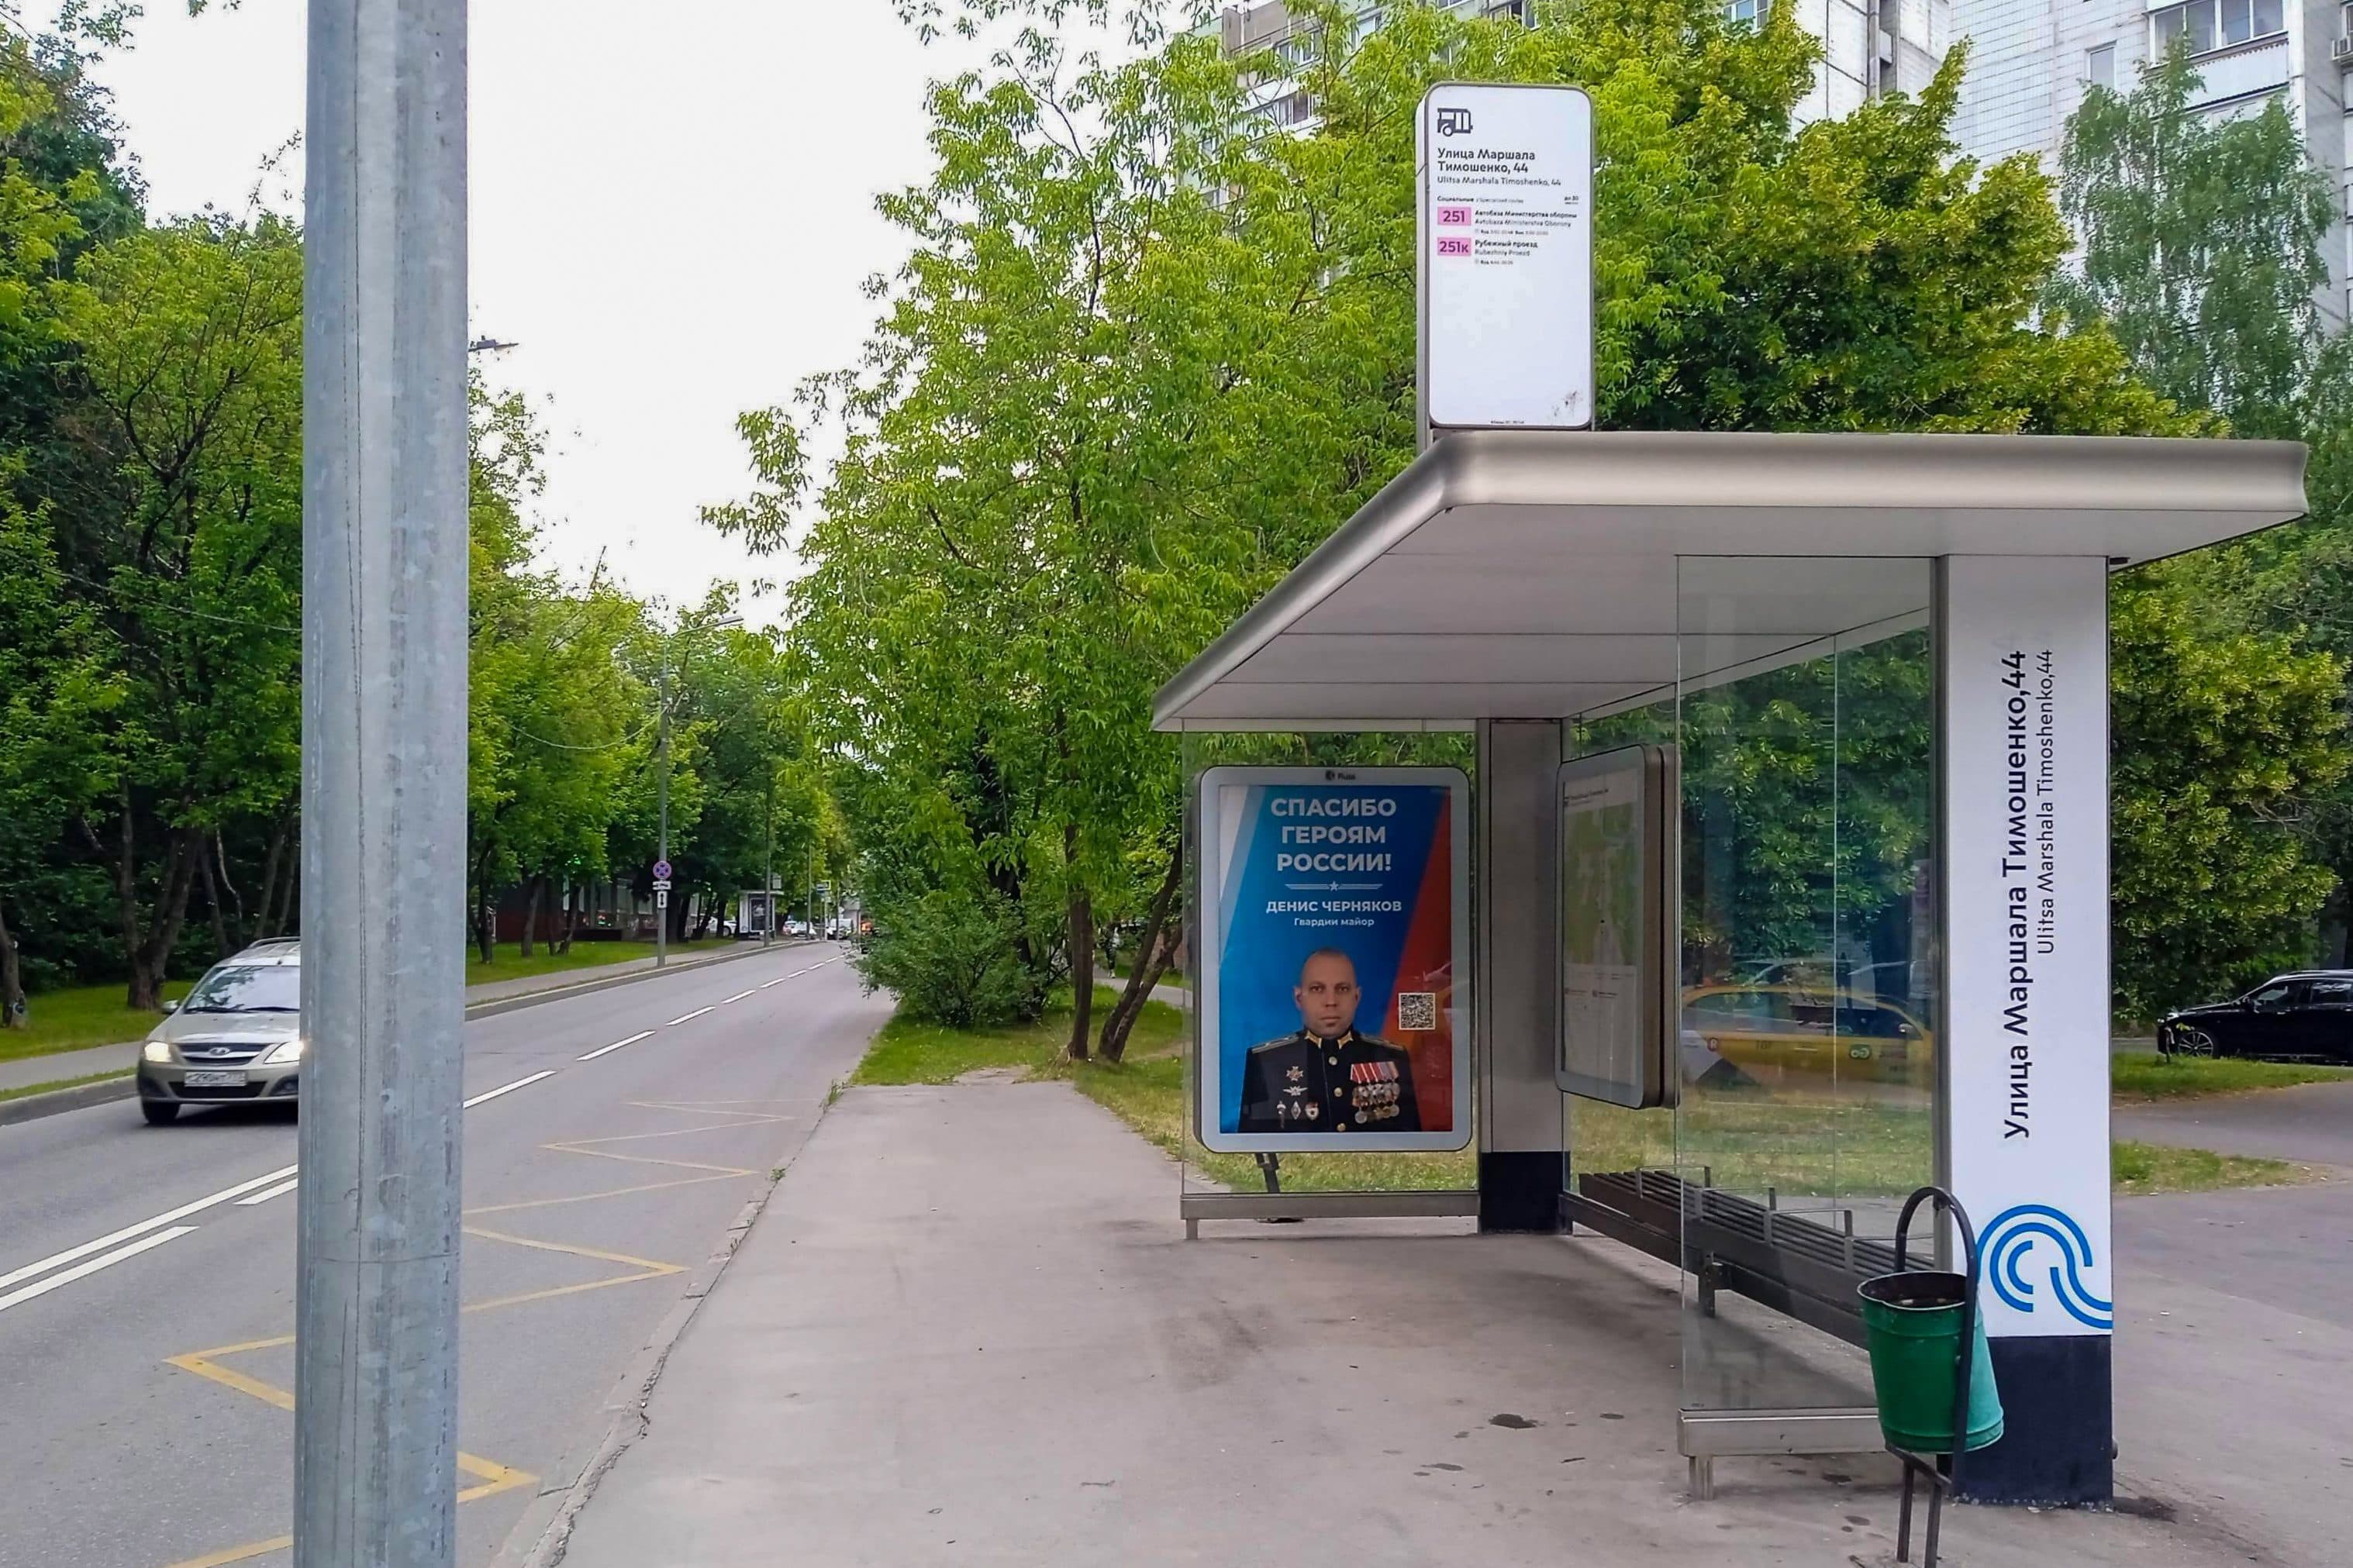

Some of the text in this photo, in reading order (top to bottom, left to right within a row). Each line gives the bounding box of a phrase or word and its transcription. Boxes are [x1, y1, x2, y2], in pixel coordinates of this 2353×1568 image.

[1437, 148, 1536, 161] Улица Маршала
[1437, 161, 1529, 174] Тимошенко, 44
[1462, 177, 1499, 185] Marshala
[1501, 177, 1550, 186] Timoshenko,
[1443, 210, 1465, 222] 251
[1271, 798, 1397, 817] СПАСИБО
[1282, 825, 1385, 843] ГЕРОЯМ
[2036, 801, 2054, 892] Marshala
[1277, 853, 1392, 871] РОССИИ!
[1266, 901, 1402, 914] ДЕНИС ЧЕРНЯКОВ
[1294, 918, 1375, 927] Гвардии майор
[2036, 898, 2055, 955] Ulitsa
[2003, 887, 2034, 1036] Маршала
[2003, 1045, 2033, 1139] Улица
